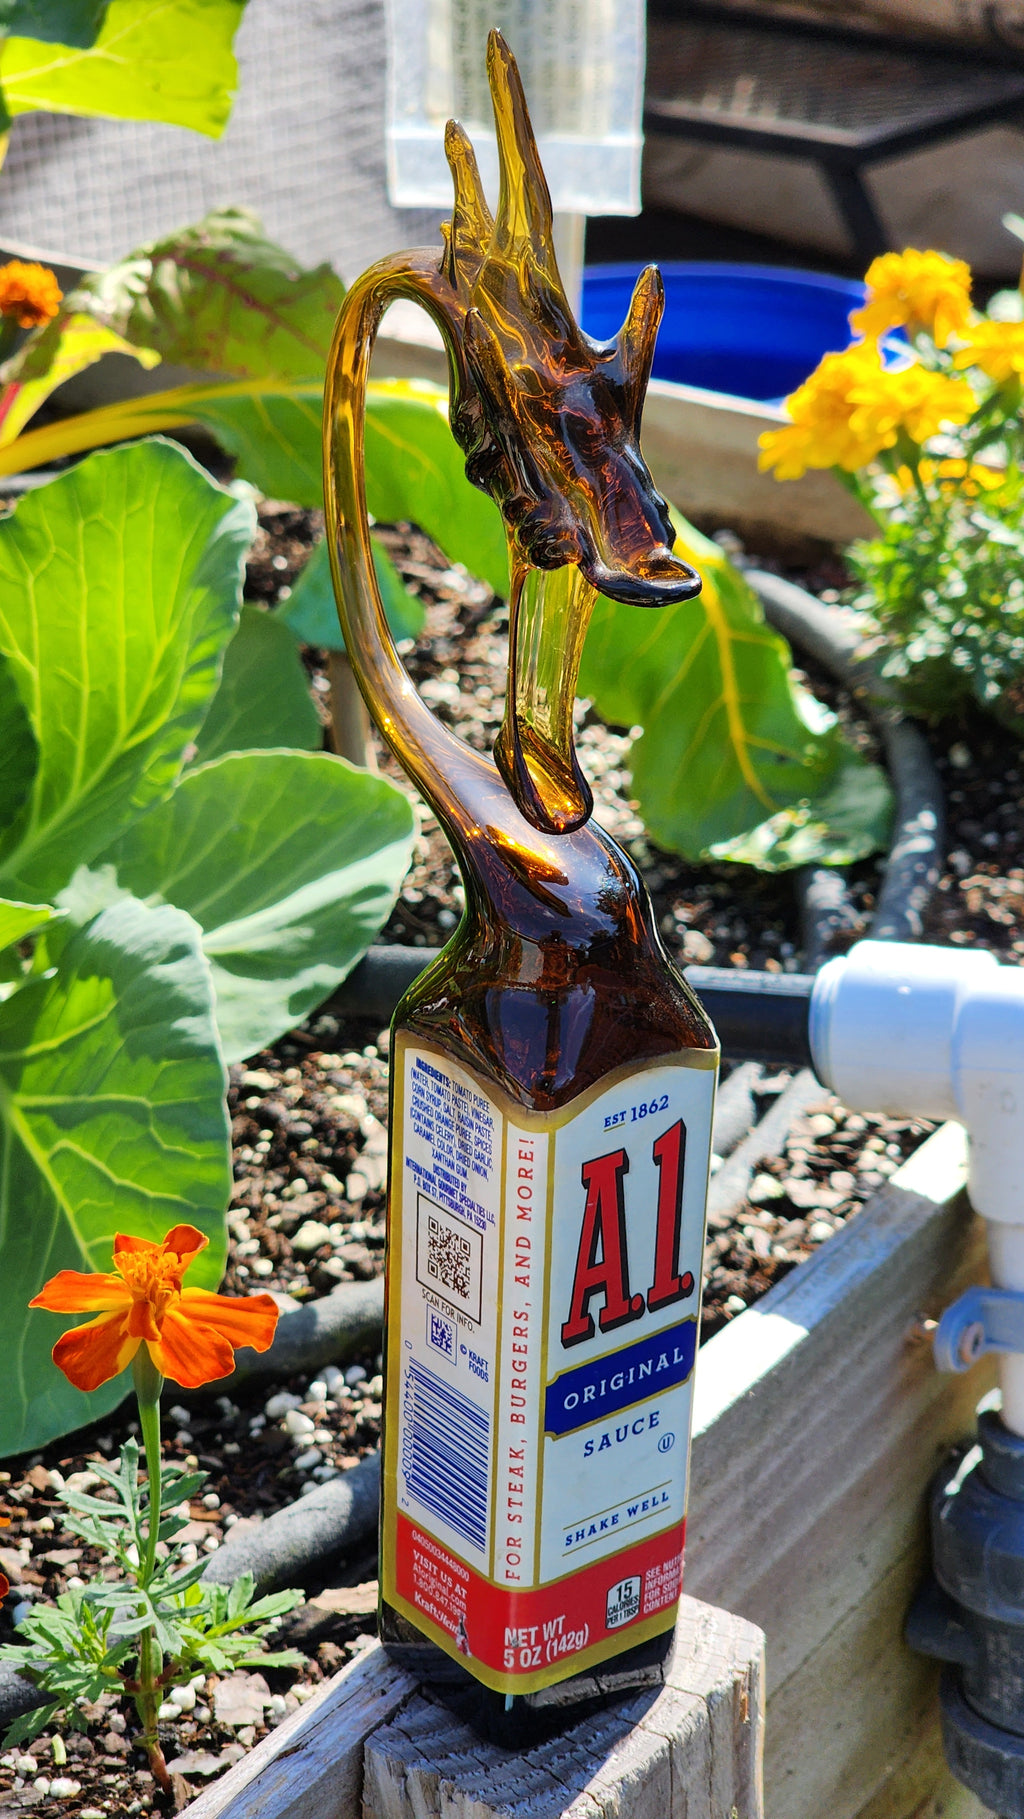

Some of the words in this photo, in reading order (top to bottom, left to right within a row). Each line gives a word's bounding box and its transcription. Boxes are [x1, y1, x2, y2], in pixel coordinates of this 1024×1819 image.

[412, 1081, 425, 1099] CORN
[443, 1101, 457, 1121] SALT,
[457, 1111, 474, 1131] RAISIN
[431, 1080, 451, 1102] TOMATO
[452, 1080, 472, 1103] TOMATO
[412, 1095, 434, 1117] CRUSHED
[434, 1110, 455, 1132] ORANGE
[474, 1135, 492, 1155] SPICES
[604, 1110, 627, 1128] EST
[630, 1094, 670, 1123] 1862
[413, 1122, 435, 1146] CARAMEL
[456, 1150, 471, 1168] DRIED
[432, 1147, 455, 1171] XANTHAN
[458, 1138, 473, 1157] DRIED
[474, 1149, 494, 1172] GARLIC,
[438, 1179, 458, 1199] GOURMET
[459, 1193, 486, 1219] SPECIALTIES
[517, 1138, 535, 1223] MORE!
[467, 1209, 473, 1221] PA
[514, 1236, 533, 1288] AND
[422, 1288, 440, 1308] SCAN
[441, 1301, 455, 1320] FOR
[456, 1314, 475, 1334] INFO.
[468, 1349, 489, 1371] KRAFT
[468, 1360, 489, 1383] FOODS
[510, 1301, 532, 1425] BURGERS,
[563, 1347, 684, 1410] ORIGINAL
[583, 1410, 660, 1458] SAUCE
[507, 1439, 528, 1523] STEAK,
[565, 1513, 620, 1546] SHAKE
[627, 1492, 670, 1518] WELL
[413, 1549, 438, 1575] VISIT
[440, 1571, 453, 1588] US
[455, 1583, 467, 1599] AT
[505, 1536, 523, 1581] FOR
[646, 1565, 661, 1580] SEE
[608, 1594, 640, 1616] CALORIES
[617, 1580, 633, 1602] 15
[644, 1587, 661, 1602] FOR
[644, 1589, 678, 1614] CONTENT
[504, 1626, 539, 1648] NET
[543, 1615, 566, 1639] WT
[607, 1614, 619, 1625] PER
[624, 1605, 639, 1619] TBSP
[504, 1648, 515, 1668] 5
[520, 1645, 542, 1668] OZ
[546, 1623, 589, 1662] (142g)
